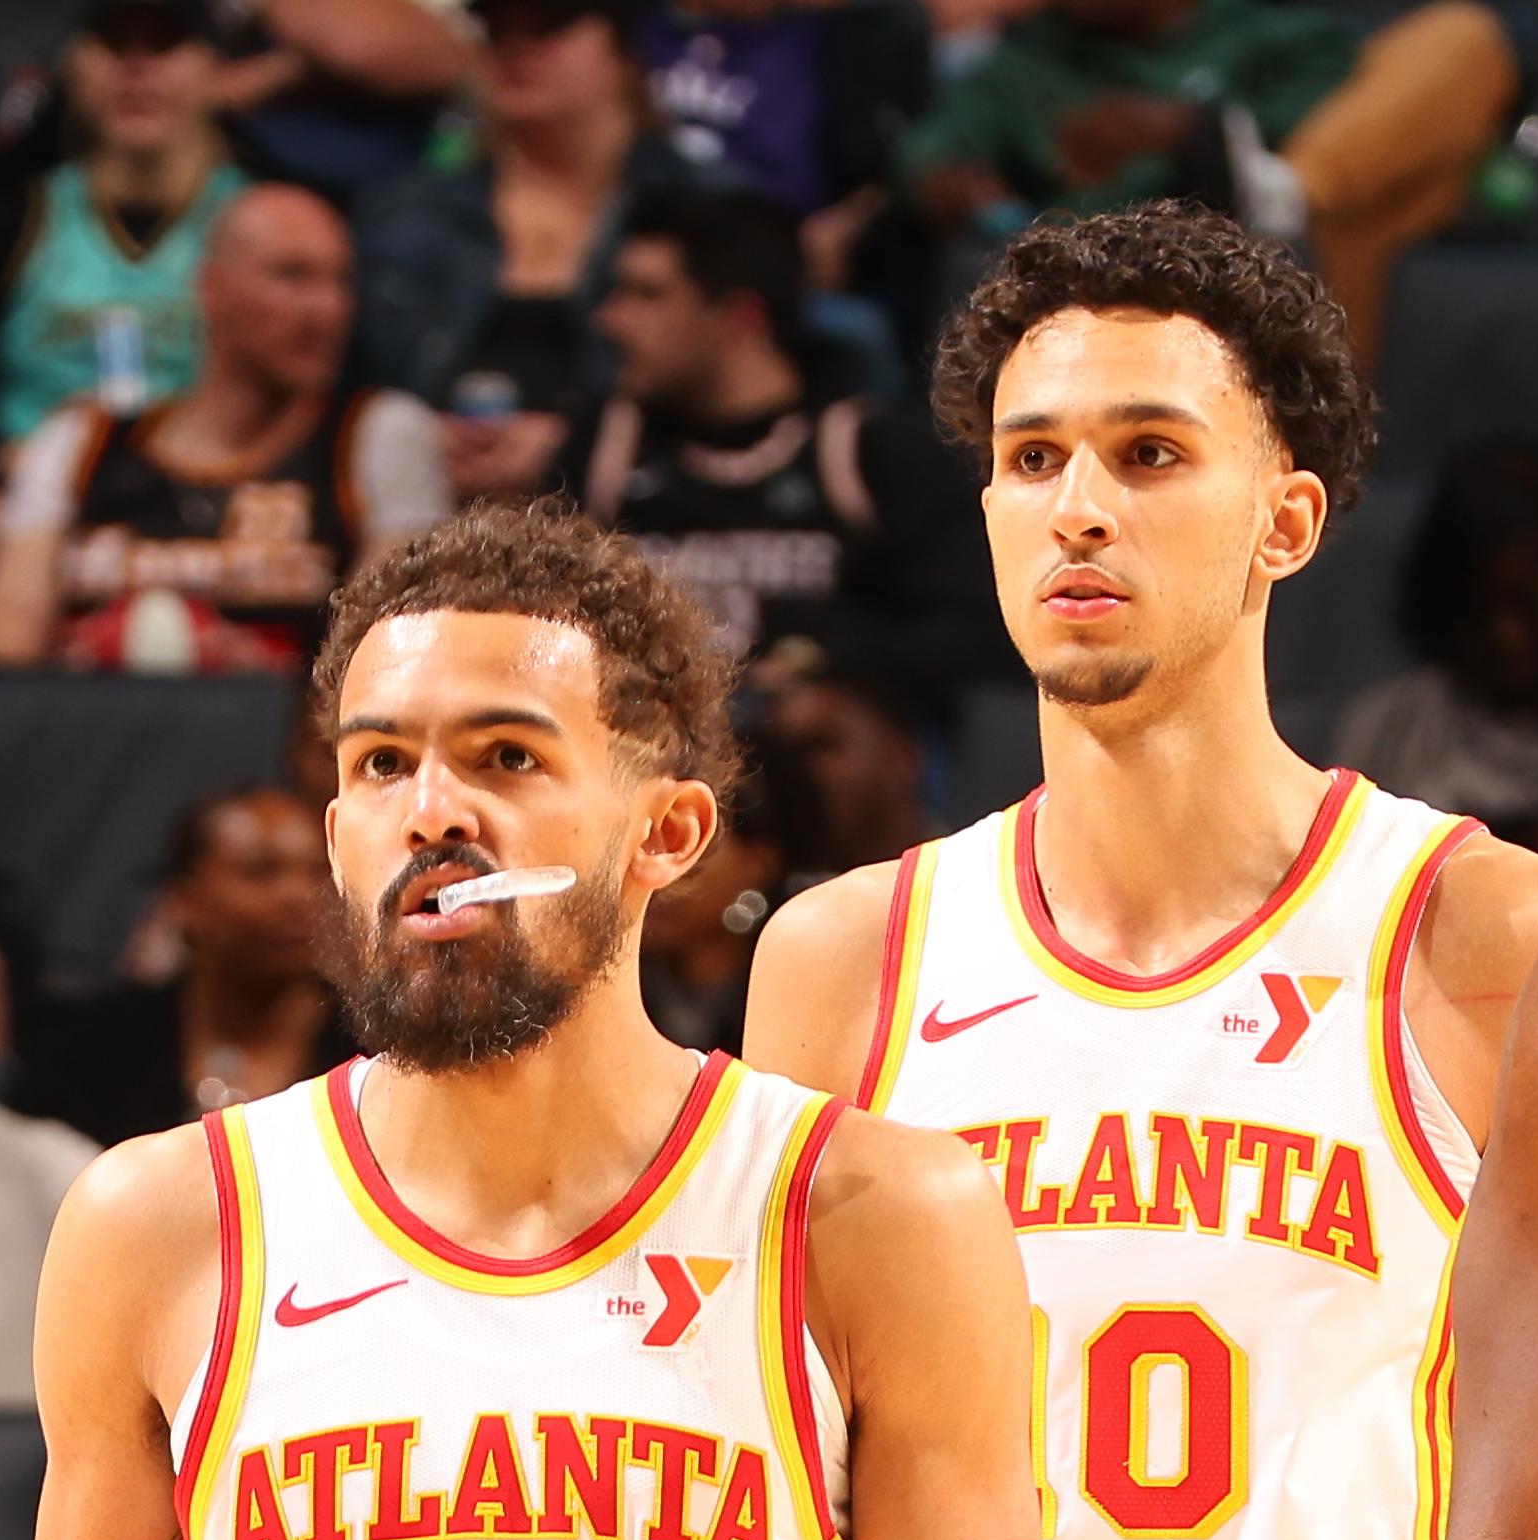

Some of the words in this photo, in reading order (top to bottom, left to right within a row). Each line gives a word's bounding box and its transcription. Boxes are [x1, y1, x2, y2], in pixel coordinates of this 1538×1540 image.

[1222, 1013, 1260, 1033] the
[948, 1111, 1382, 1280] LANTA
[606, 1295, 646, 1316] the
